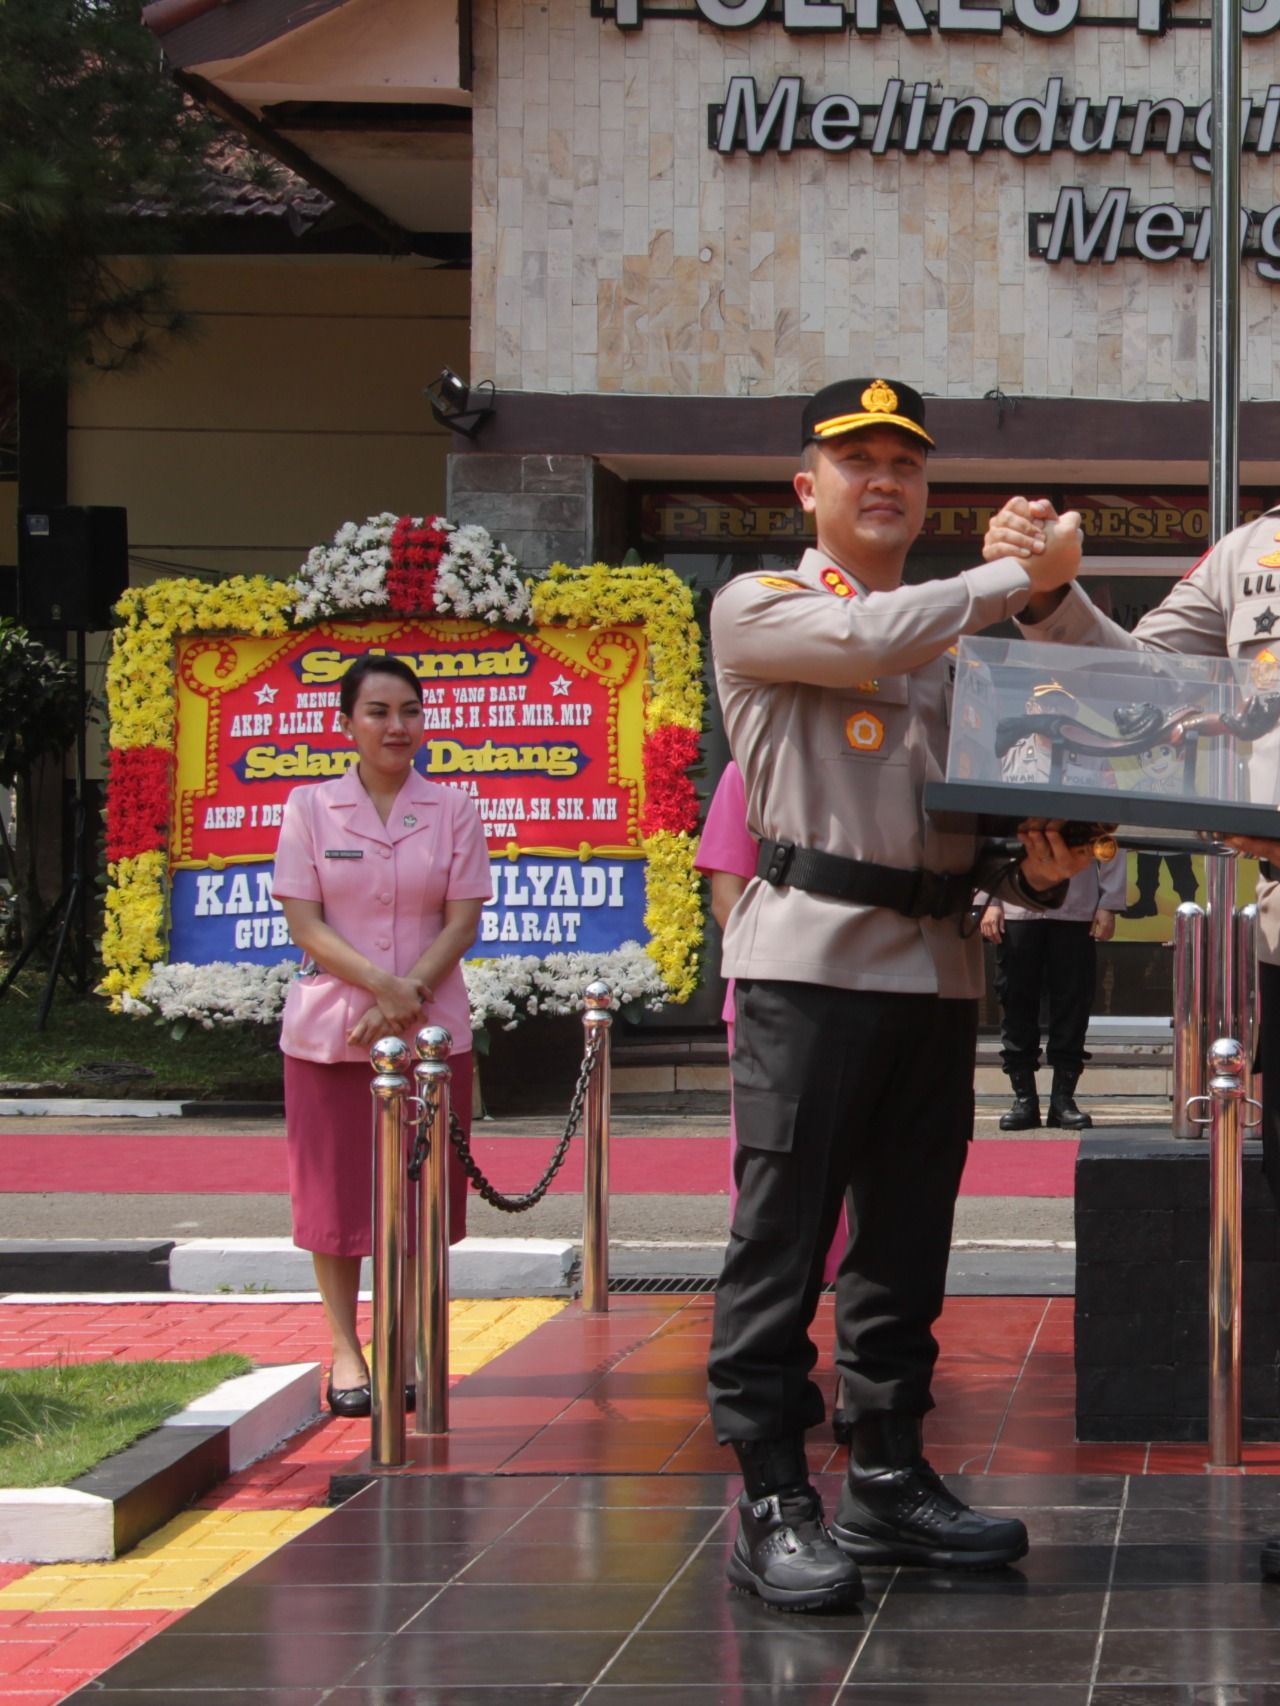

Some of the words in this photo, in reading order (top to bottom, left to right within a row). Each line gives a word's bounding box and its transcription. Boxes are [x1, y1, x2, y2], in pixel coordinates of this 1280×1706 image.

[302, 642, 529, 684] Smat
[297, 692, 341, 708] MENGA
[423, 688, 445, 704] PAT
[453, 687, 485, 704] YANG
[490, 685, 527, 702] BARU
[230, 714, 272, 737] AKBP
[279, 711, 324, 735] LILIK
[426, 739, 578, 776] Datang
[204, 806, 245, 829] AKBP
[251, 805, 258, 827] I
[261, 804, 287, 827] DE
[483, 823, 517, 837] EWA
[194, 872, 284, 916] KAN
[235, 917, 294, 949] GUB
[481, 912, 581, 942] BARAT
